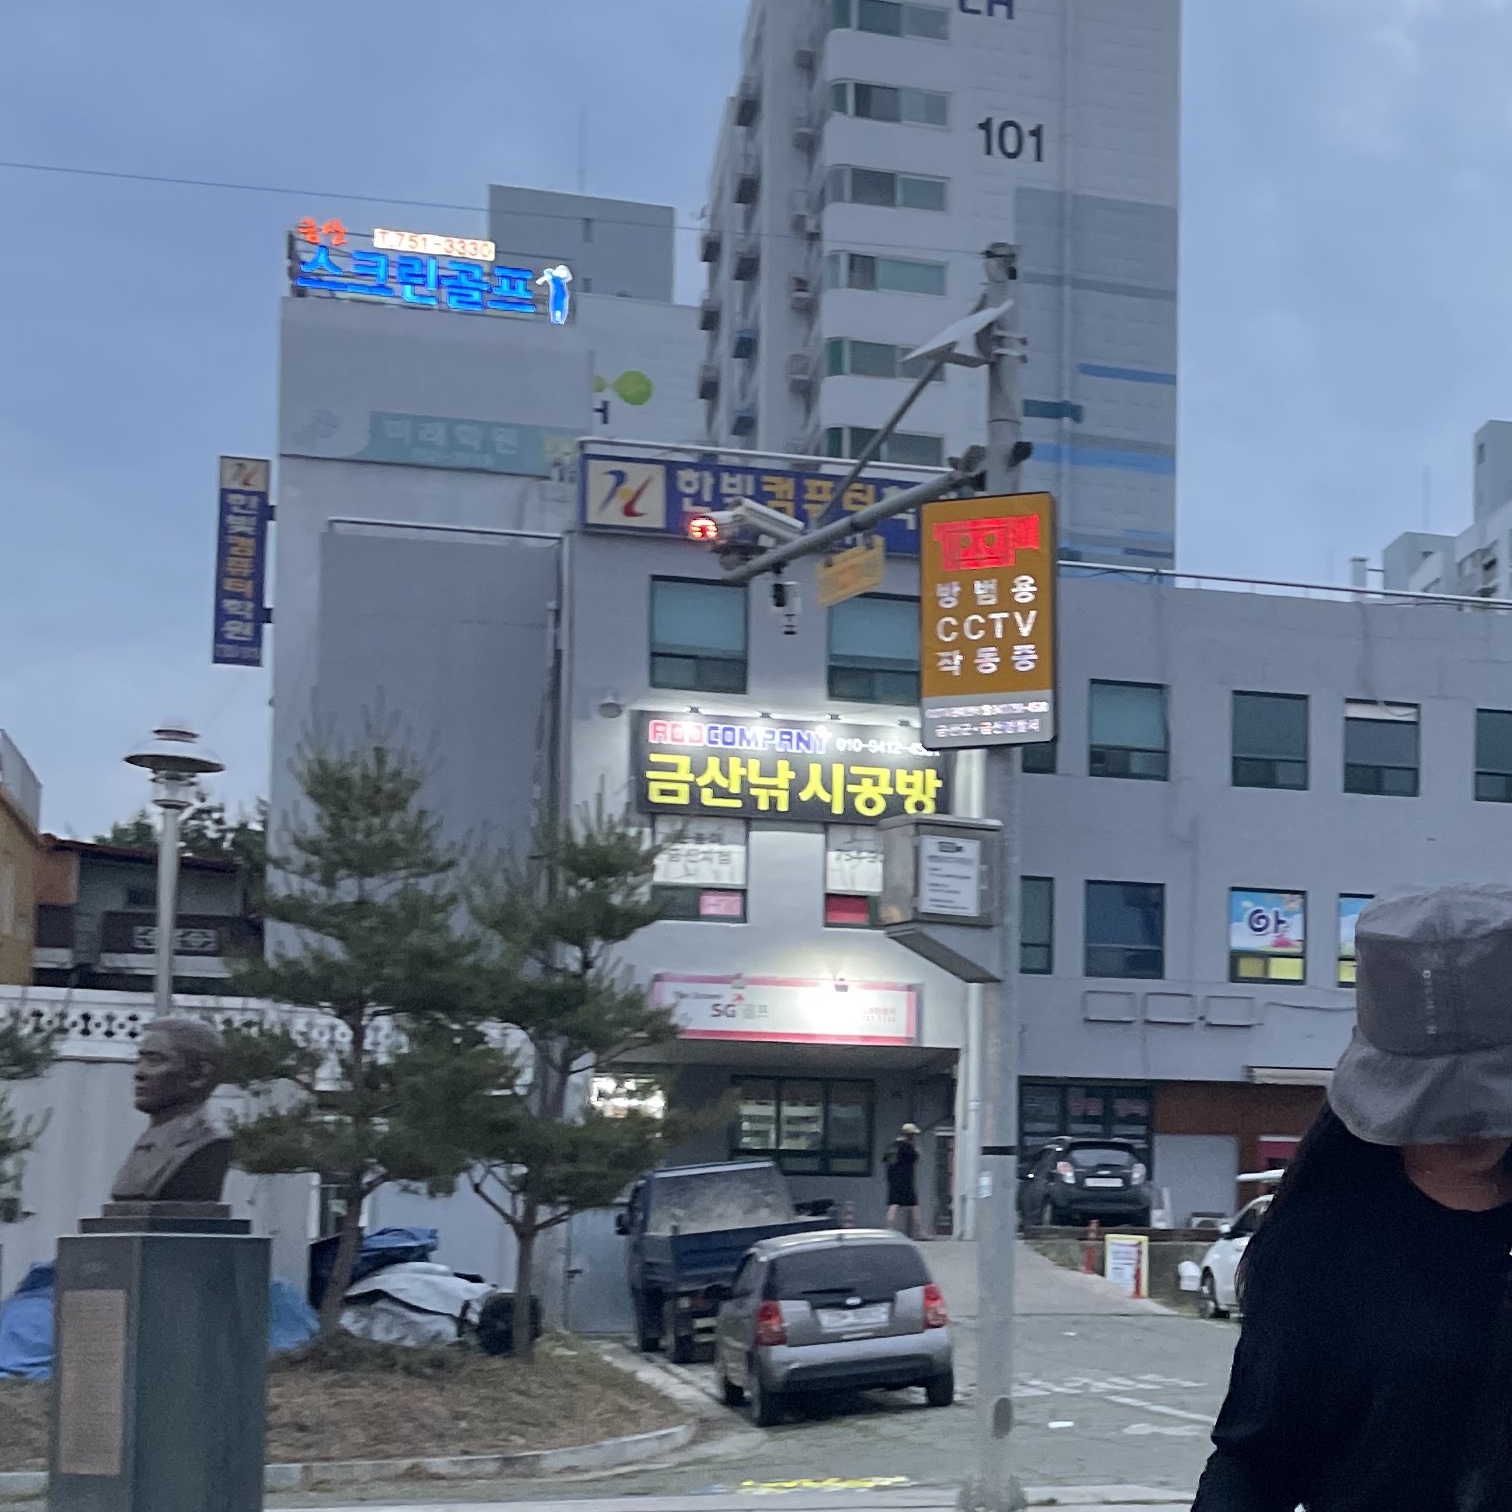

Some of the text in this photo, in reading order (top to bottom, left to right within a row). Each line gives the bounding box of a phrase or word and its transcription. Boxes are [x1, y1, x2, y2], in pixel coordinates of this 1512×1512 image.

[977, 116, 1045, 163] 101
[296, 245, 537, 314] 스크린골프
[935, 574, 1038, 609] 방범용
[936, 609, 1038, 642] CCTV
[935, 643, 1039, 677] 작동중
[1248, 907, 1288, 934] 아
[711, 1003, 737, 1018] SG
